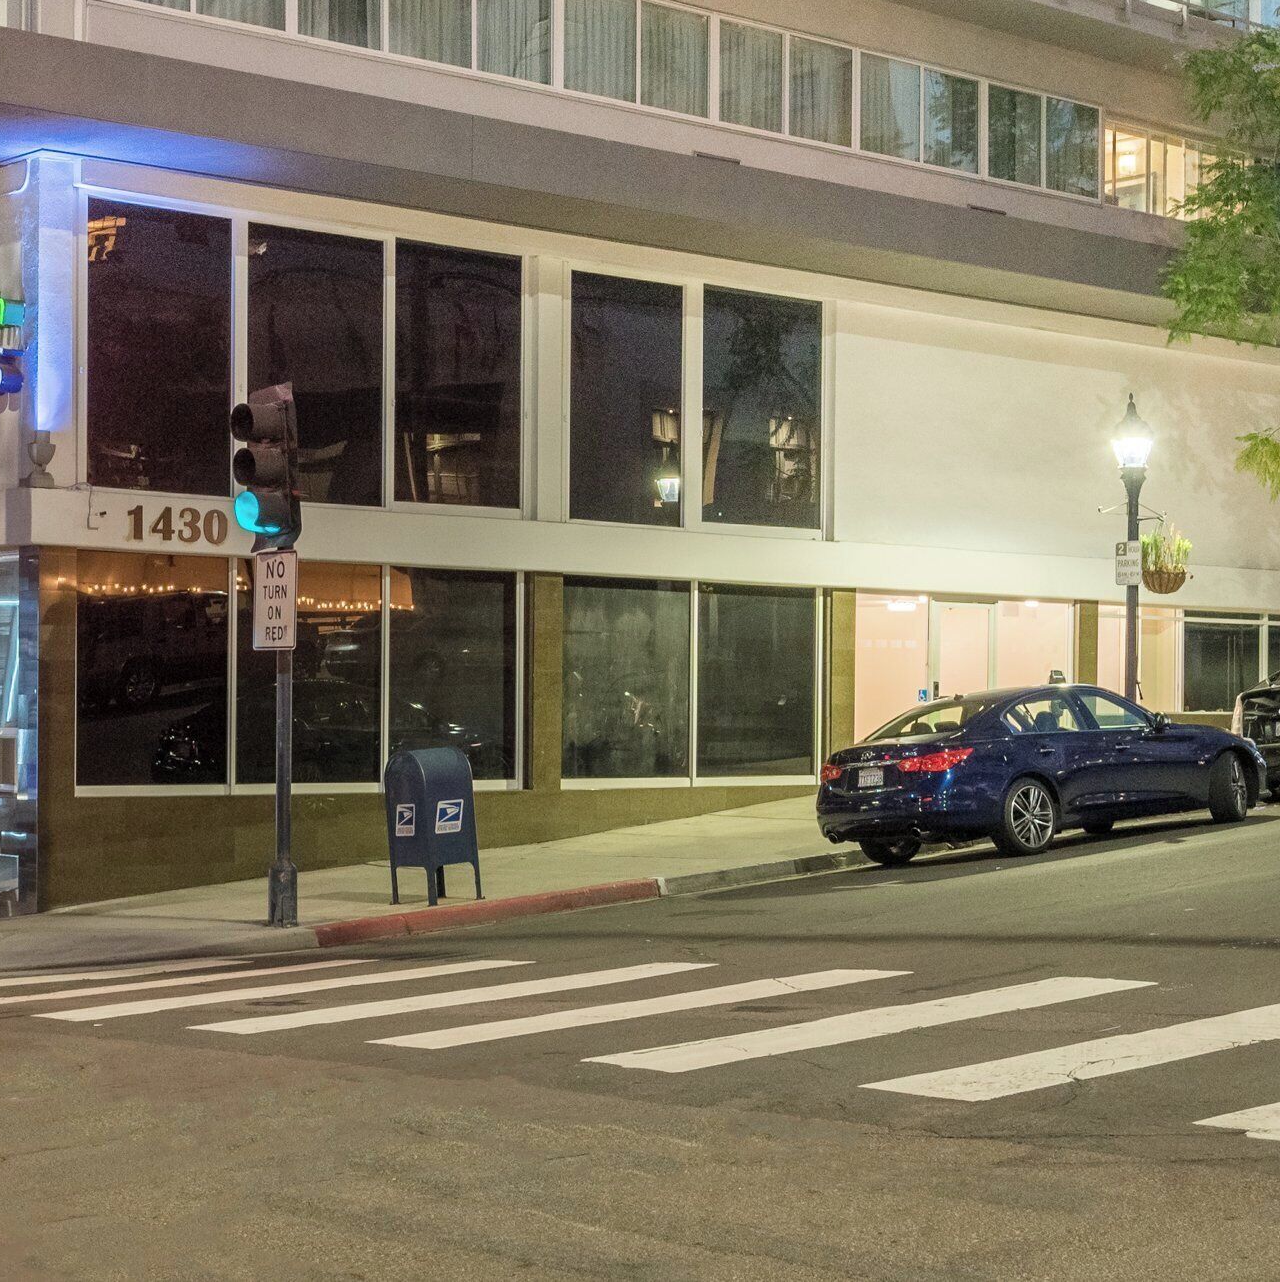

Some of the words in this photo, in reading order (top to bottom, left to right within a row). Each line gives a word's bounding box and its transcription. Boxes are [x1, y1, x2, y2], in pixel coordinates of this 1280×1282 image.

[127, 505, 228, 544] 1430
[1118, 543, 1125, 555] 2
[266, 561, 285, 579] NO
[1117, 559, 1140, 568] PARKING
[263, 585, 287, 600] TURN
[268, 605, 282, 620] ON
[265, 626, 284, 641] RED
